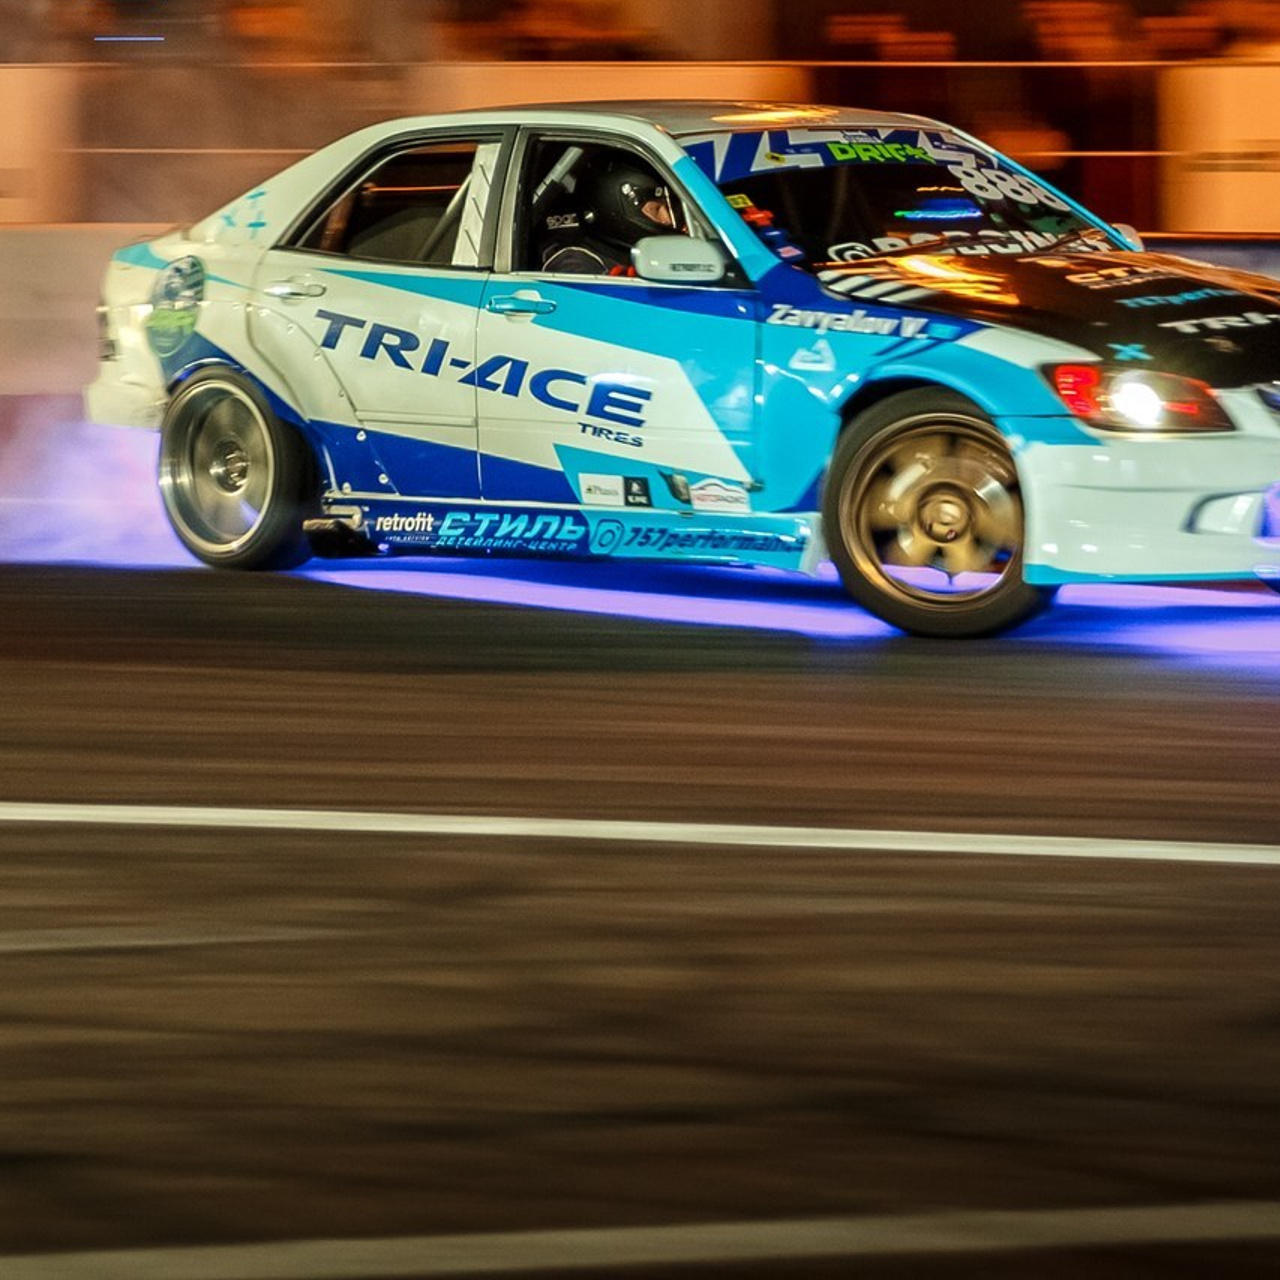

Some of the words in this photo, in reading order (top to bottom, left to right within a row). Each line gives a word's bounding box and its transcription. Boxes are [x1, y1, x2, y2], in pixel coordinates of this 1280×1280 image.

[316, 309, 652, 428] TRI-ACE
[577, 421, 644, 448] TIRES
[375, 511, 434, 532] retrofit
[438, 511, 586, 540] СТИЛЬ
